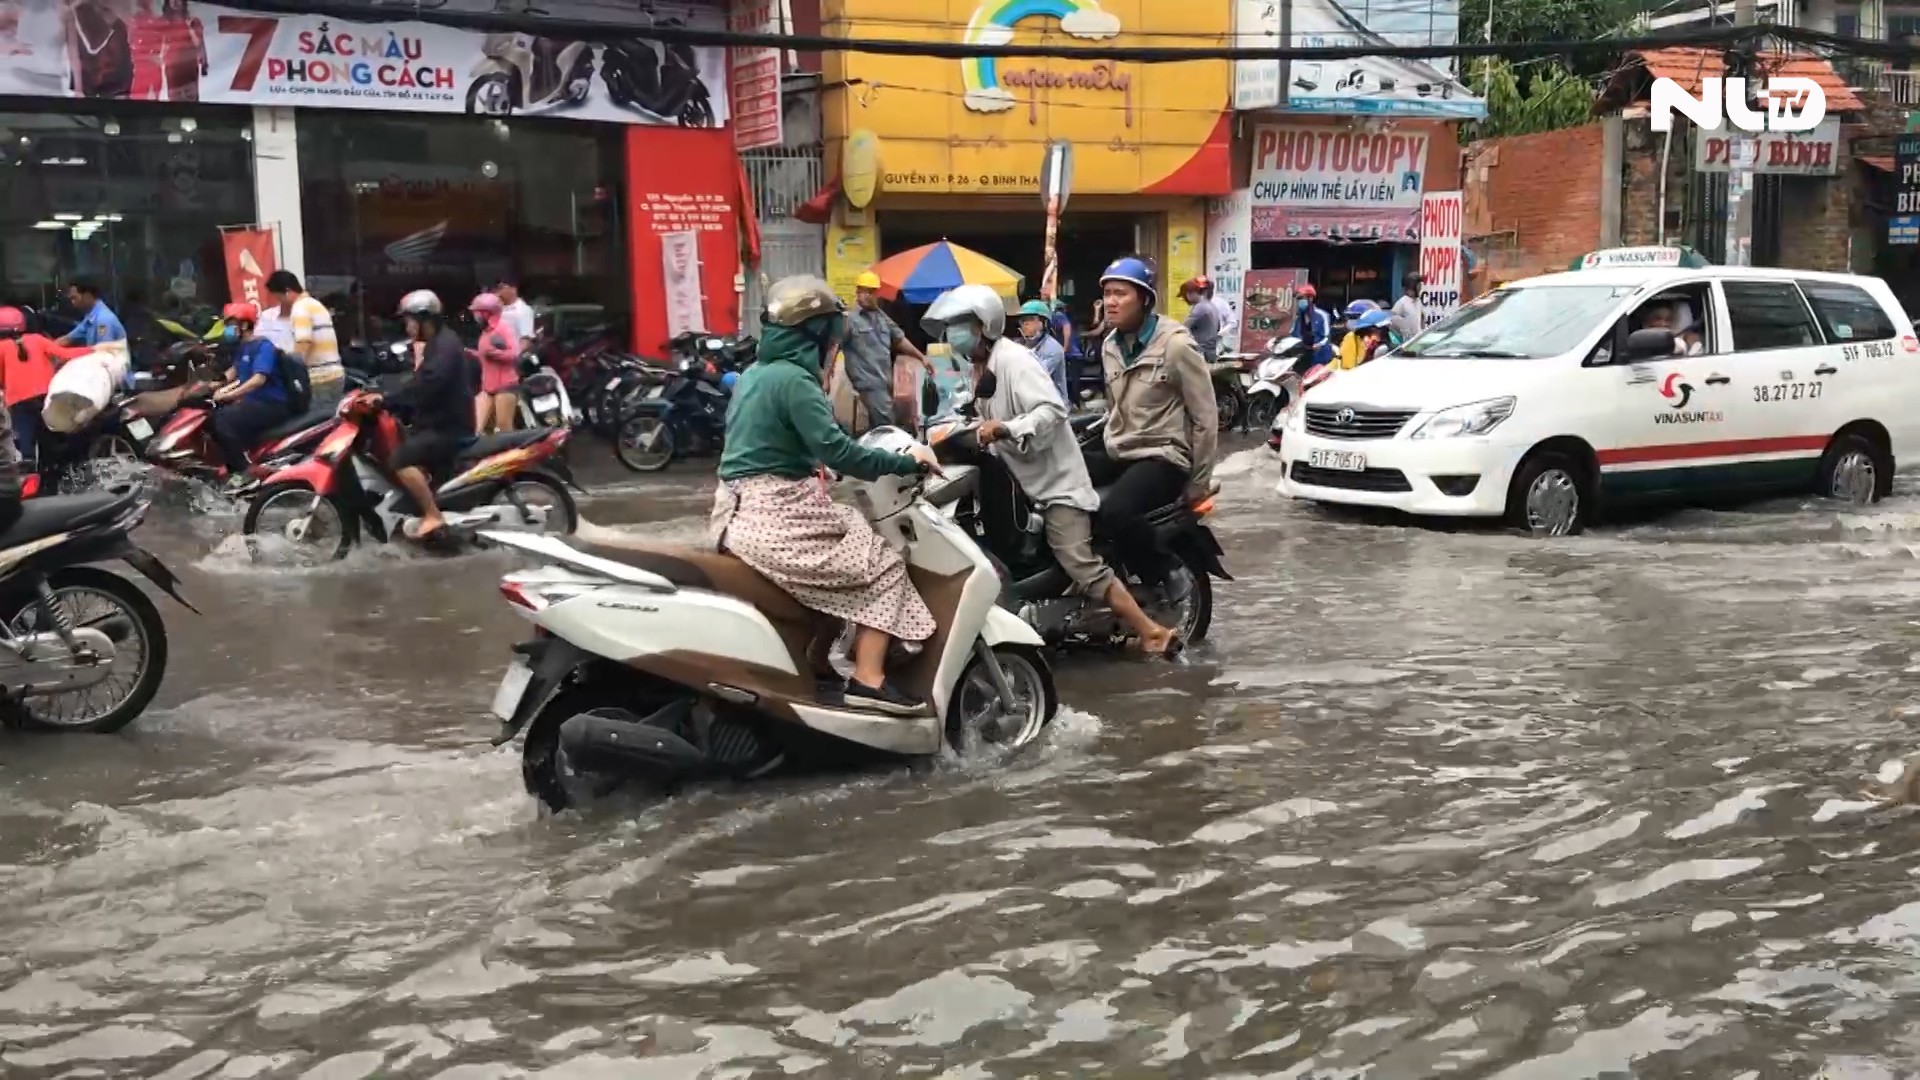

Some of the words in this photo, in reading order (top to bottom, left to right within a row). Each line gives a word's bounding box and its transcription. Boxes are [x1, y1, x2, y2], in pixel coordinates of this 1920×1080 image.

[217, 15, 280, 91] 7
[298, 21, 354, 56] SẮC
[361, 30, 422, 60] MÀU
[268, 58, 373, 85] PHONG
[377, 60, 454, 89] CÁCH
[1257, 129, 1424, 174] PHOTOCOPY
[1254, 181, 1289, 202] CHỤP
[1422, 199, 1460, 238] PHOTO
[1421, 247, 1459, 286] COPPY
[1420, 291, 1459, 310] CHỤP
